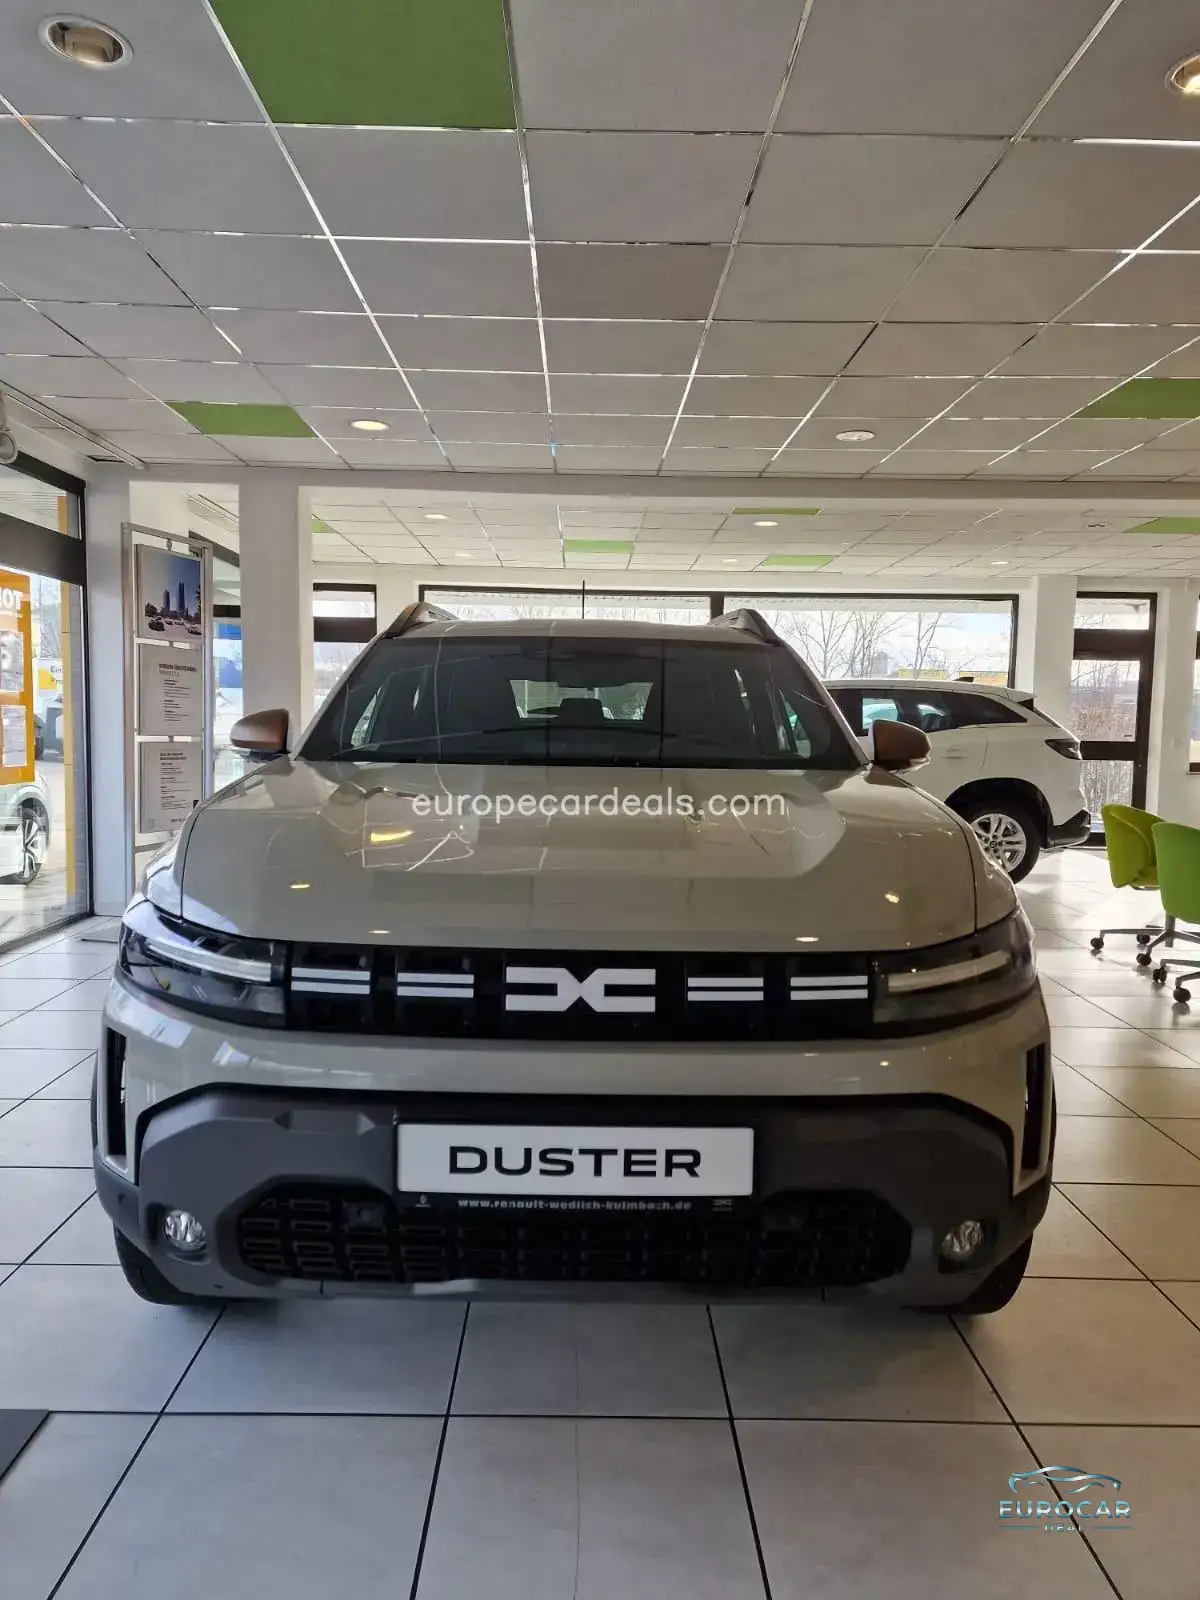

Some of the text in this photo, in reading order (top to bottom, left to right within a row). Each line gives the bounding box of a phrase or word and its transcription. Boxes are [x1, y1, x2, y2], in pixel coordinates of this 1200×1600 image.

[0, 587, 23, 610] OT
[449, 1146, 702, 1178] DUSTER
[457, 1199, 692, 1212] www.renault-wedlich-kulmbach.de
